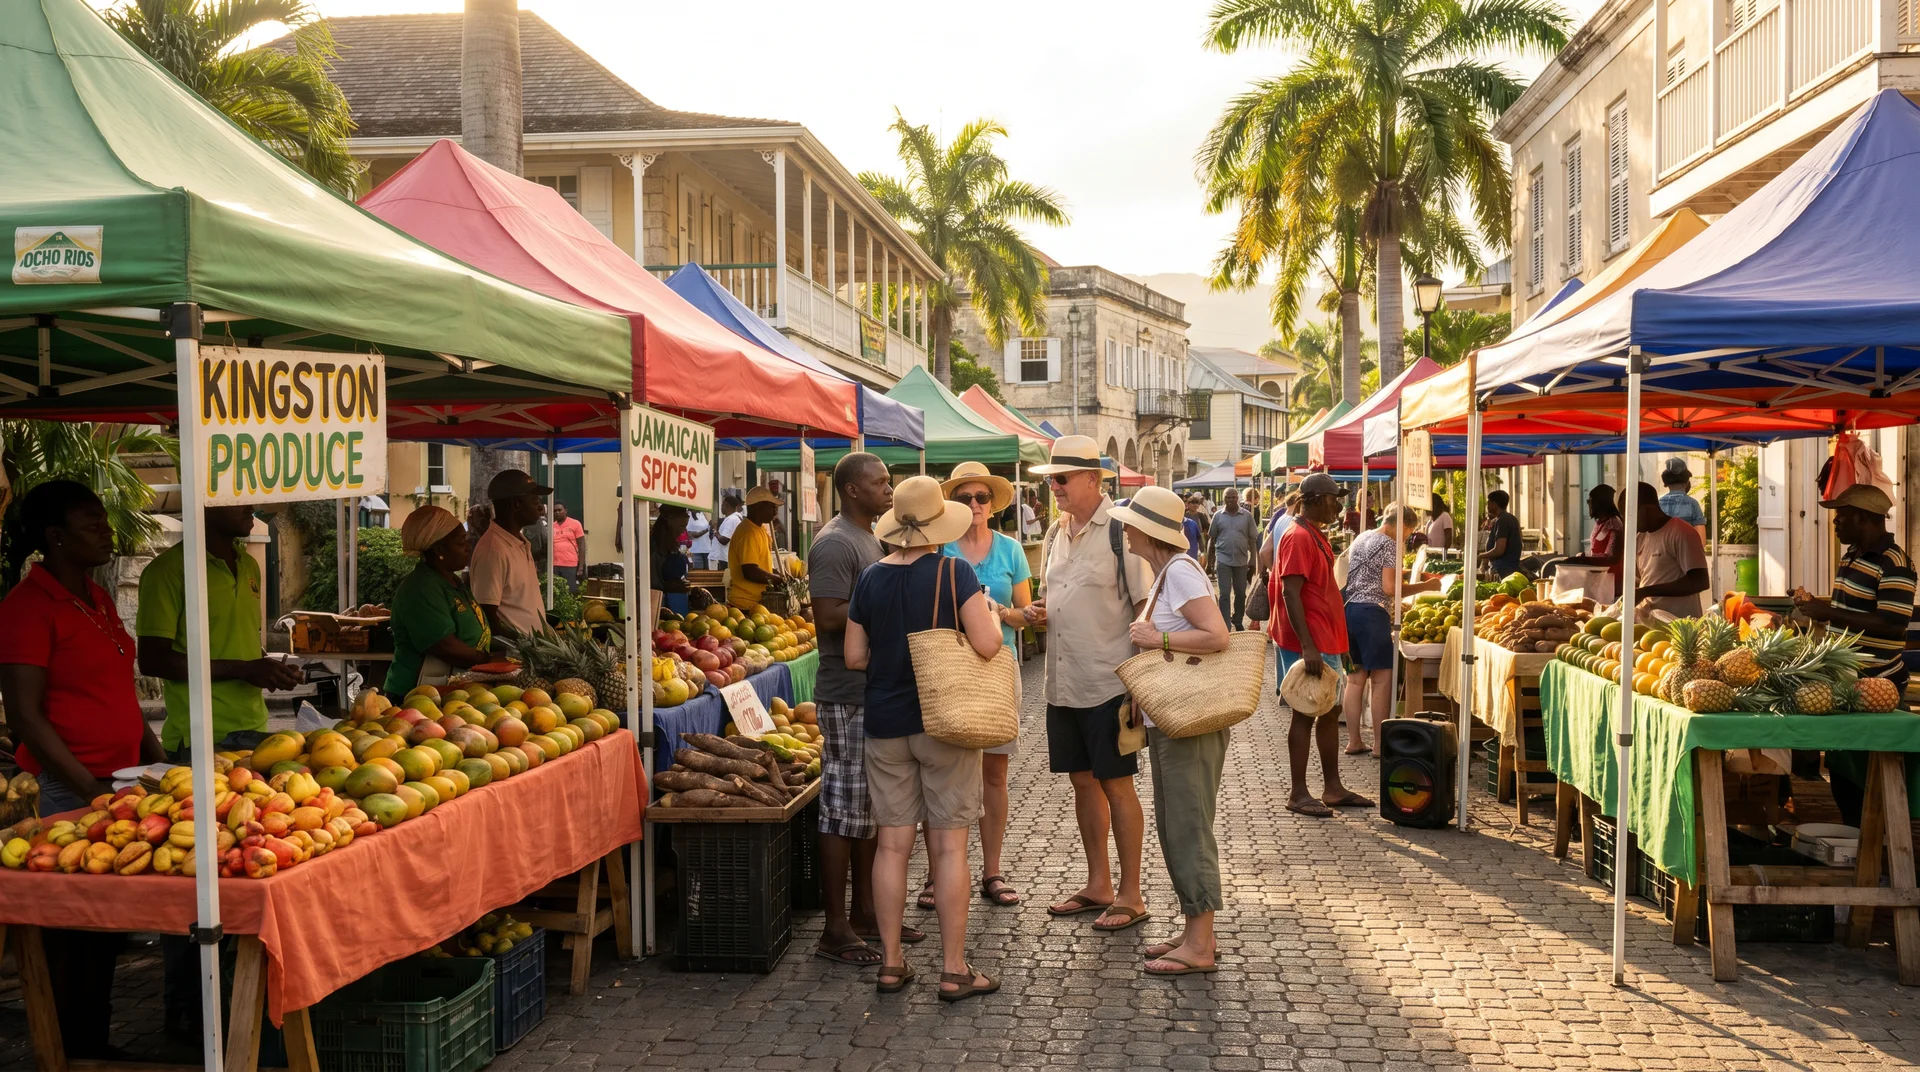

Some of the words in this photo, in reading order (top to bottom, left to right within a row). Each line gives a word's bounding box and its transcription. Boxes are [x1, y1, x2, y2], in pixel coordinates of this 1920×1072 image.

[63, 249, 94, 268] RIOS
[200, 358, 378, 424] KINGSTON
[208, 431, 364, 497] PRODUCE
[631, 413, 710, 465] JAMAICAN
[641, 455, 697, 500] SPICES
